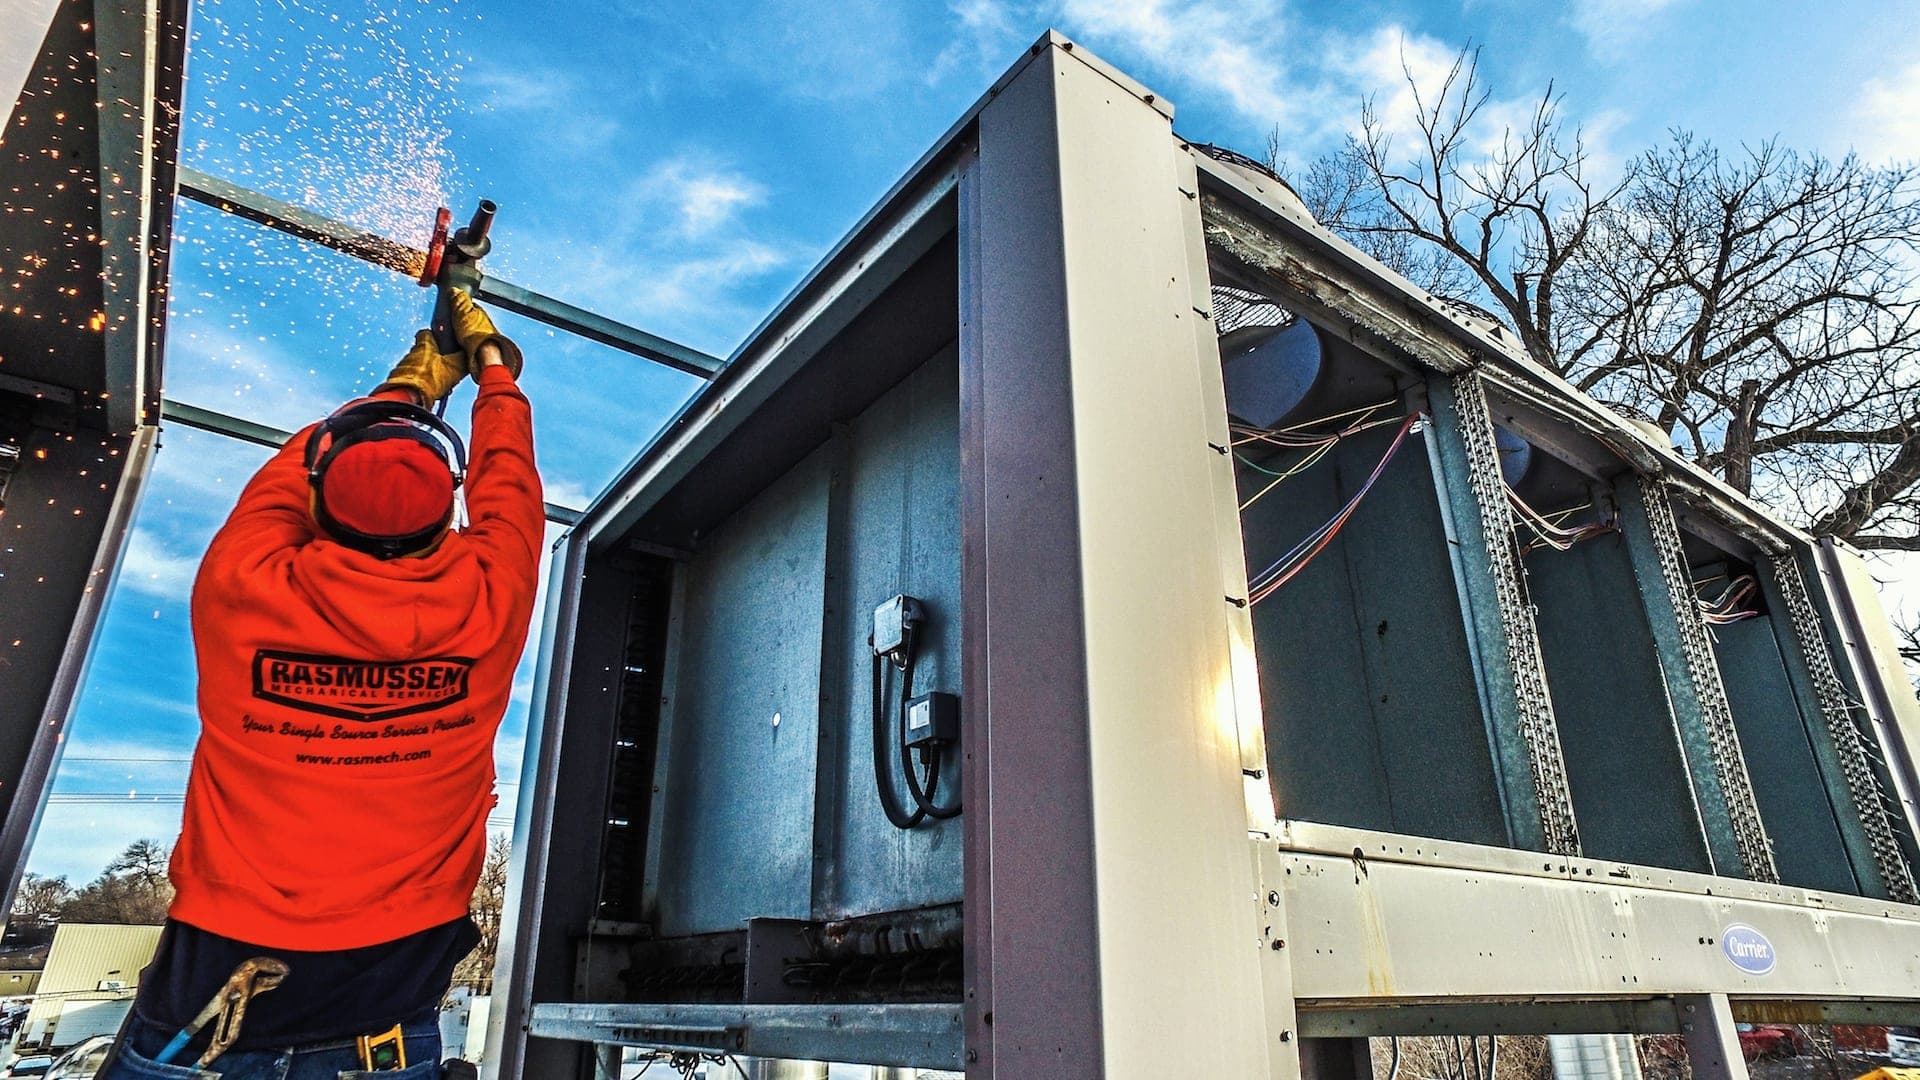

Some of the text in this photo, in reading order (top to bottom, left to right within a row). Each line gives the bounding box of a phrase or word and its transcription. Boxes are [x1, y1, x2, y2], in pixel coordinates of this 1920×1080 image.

[271, 661, 463, 690] RASMUSSEN
[271, 684, 456, 699] MECHANICAL SERVICES
[242, 714, 475, 742] Your Single Source Service Provider
[296, 749, 431, 766] www.rasmech.com
[1730, 936, 1768, 959] Carrier
